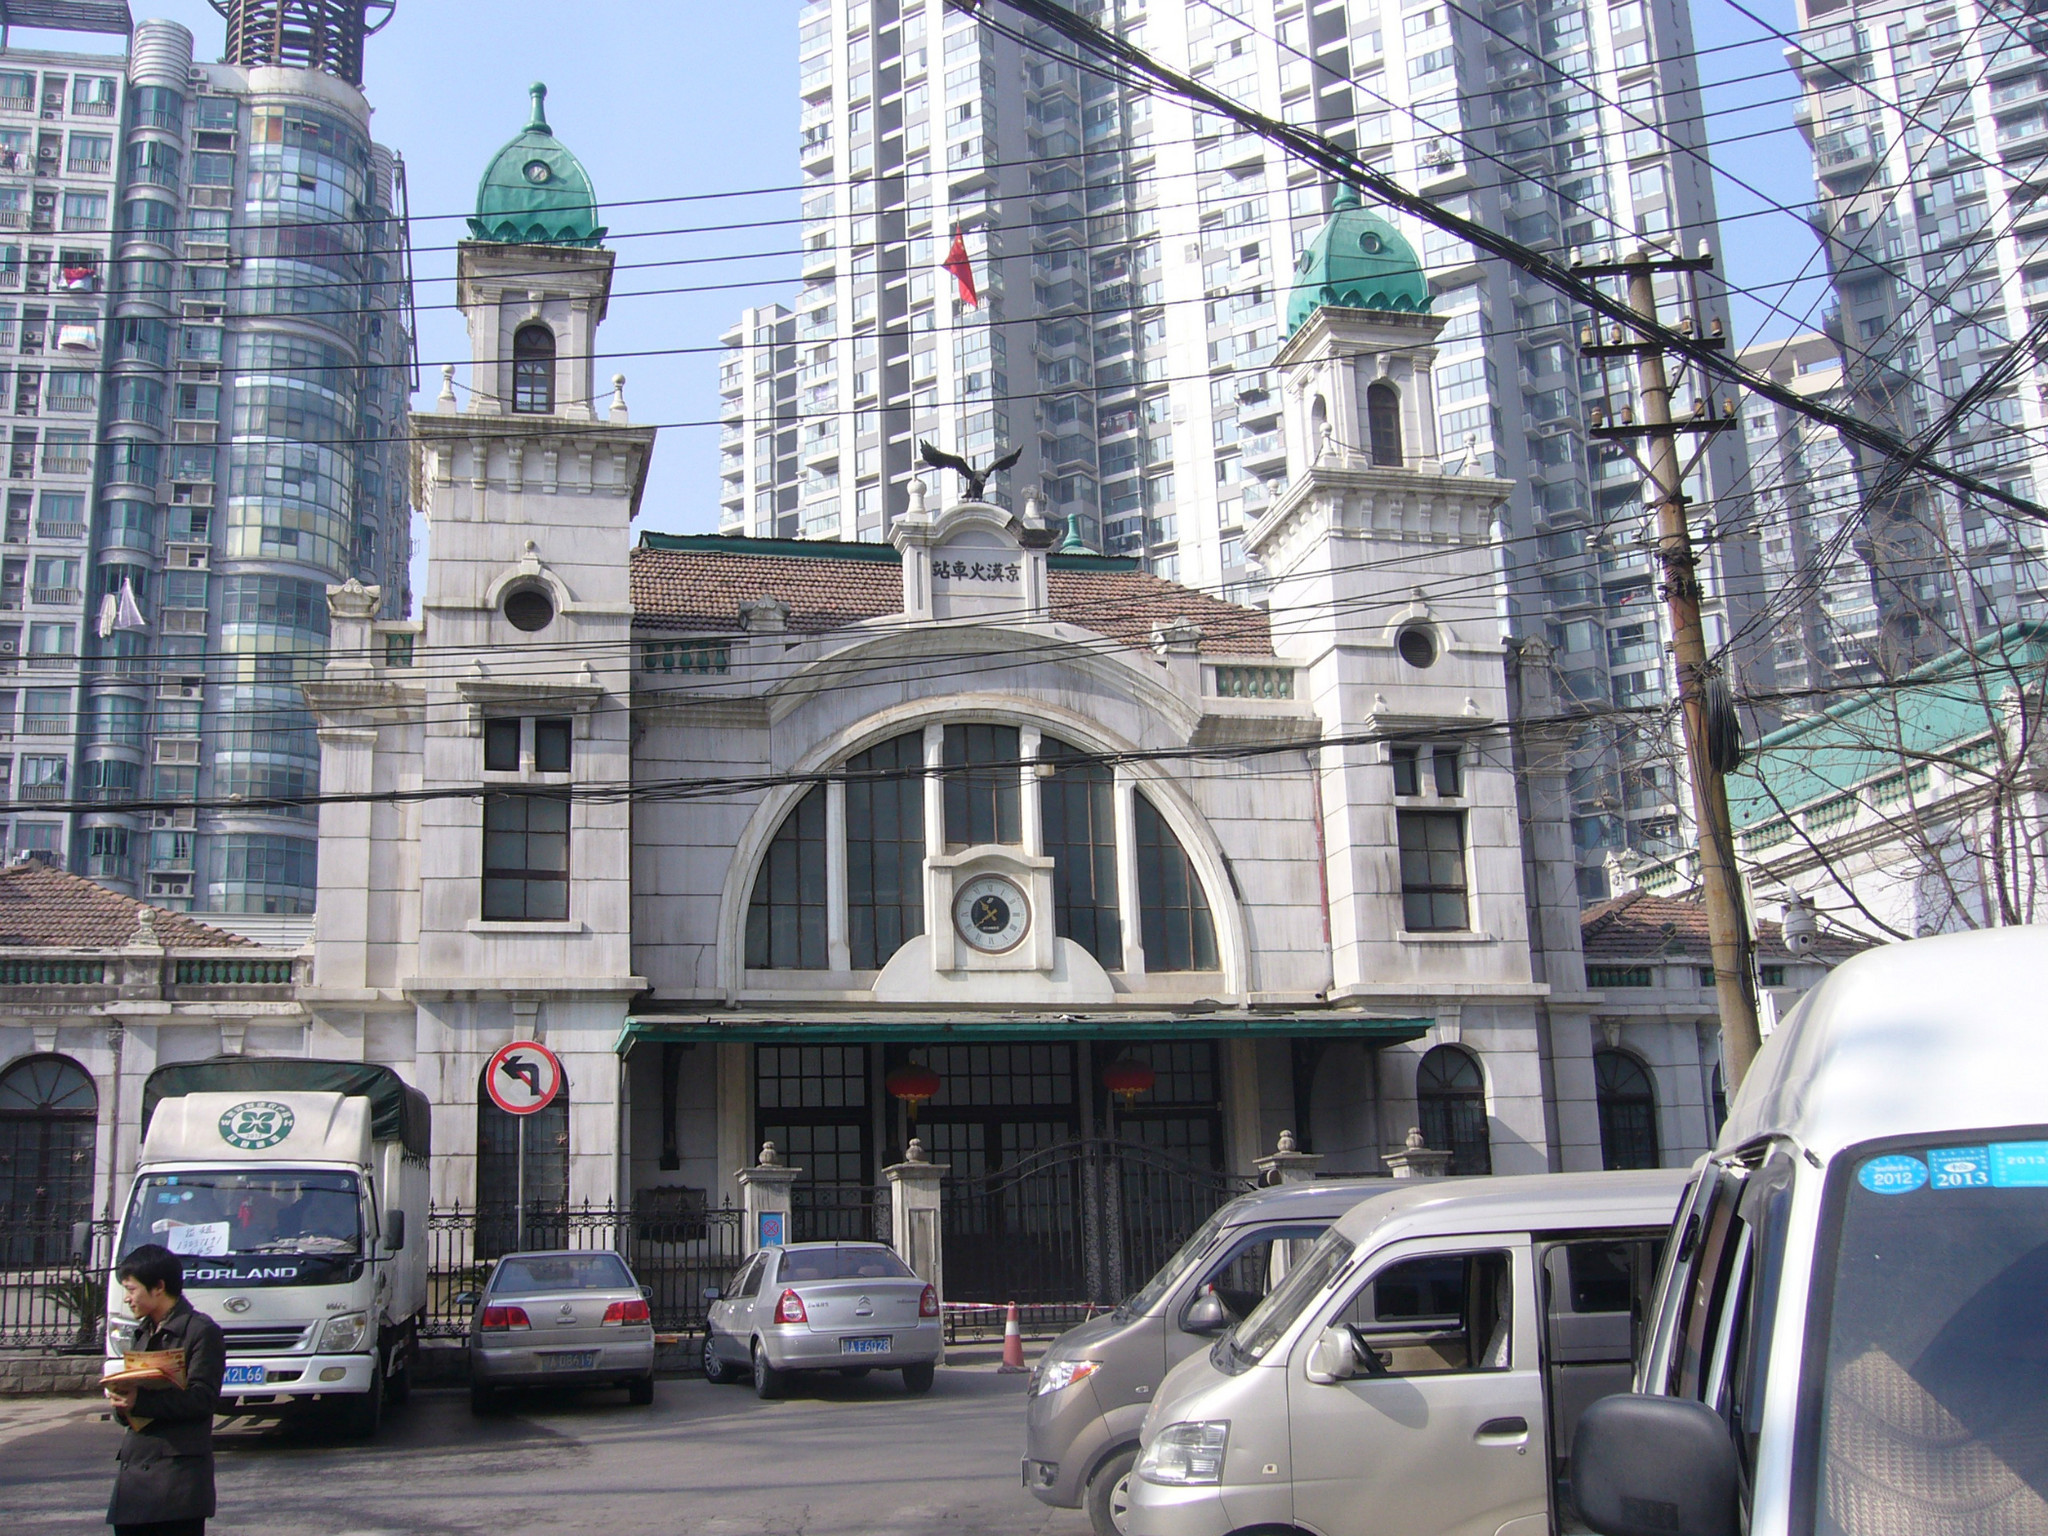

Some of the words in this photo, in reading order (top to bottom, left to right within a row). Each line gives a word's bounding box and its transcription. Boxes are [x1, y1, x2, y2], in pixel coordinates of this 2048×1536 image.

[1873, 1172, 1913, 1186] 2012
[1936, 1171, 1989, 1187] 2013
[182, 1267, 298, 1280] FORLAND
